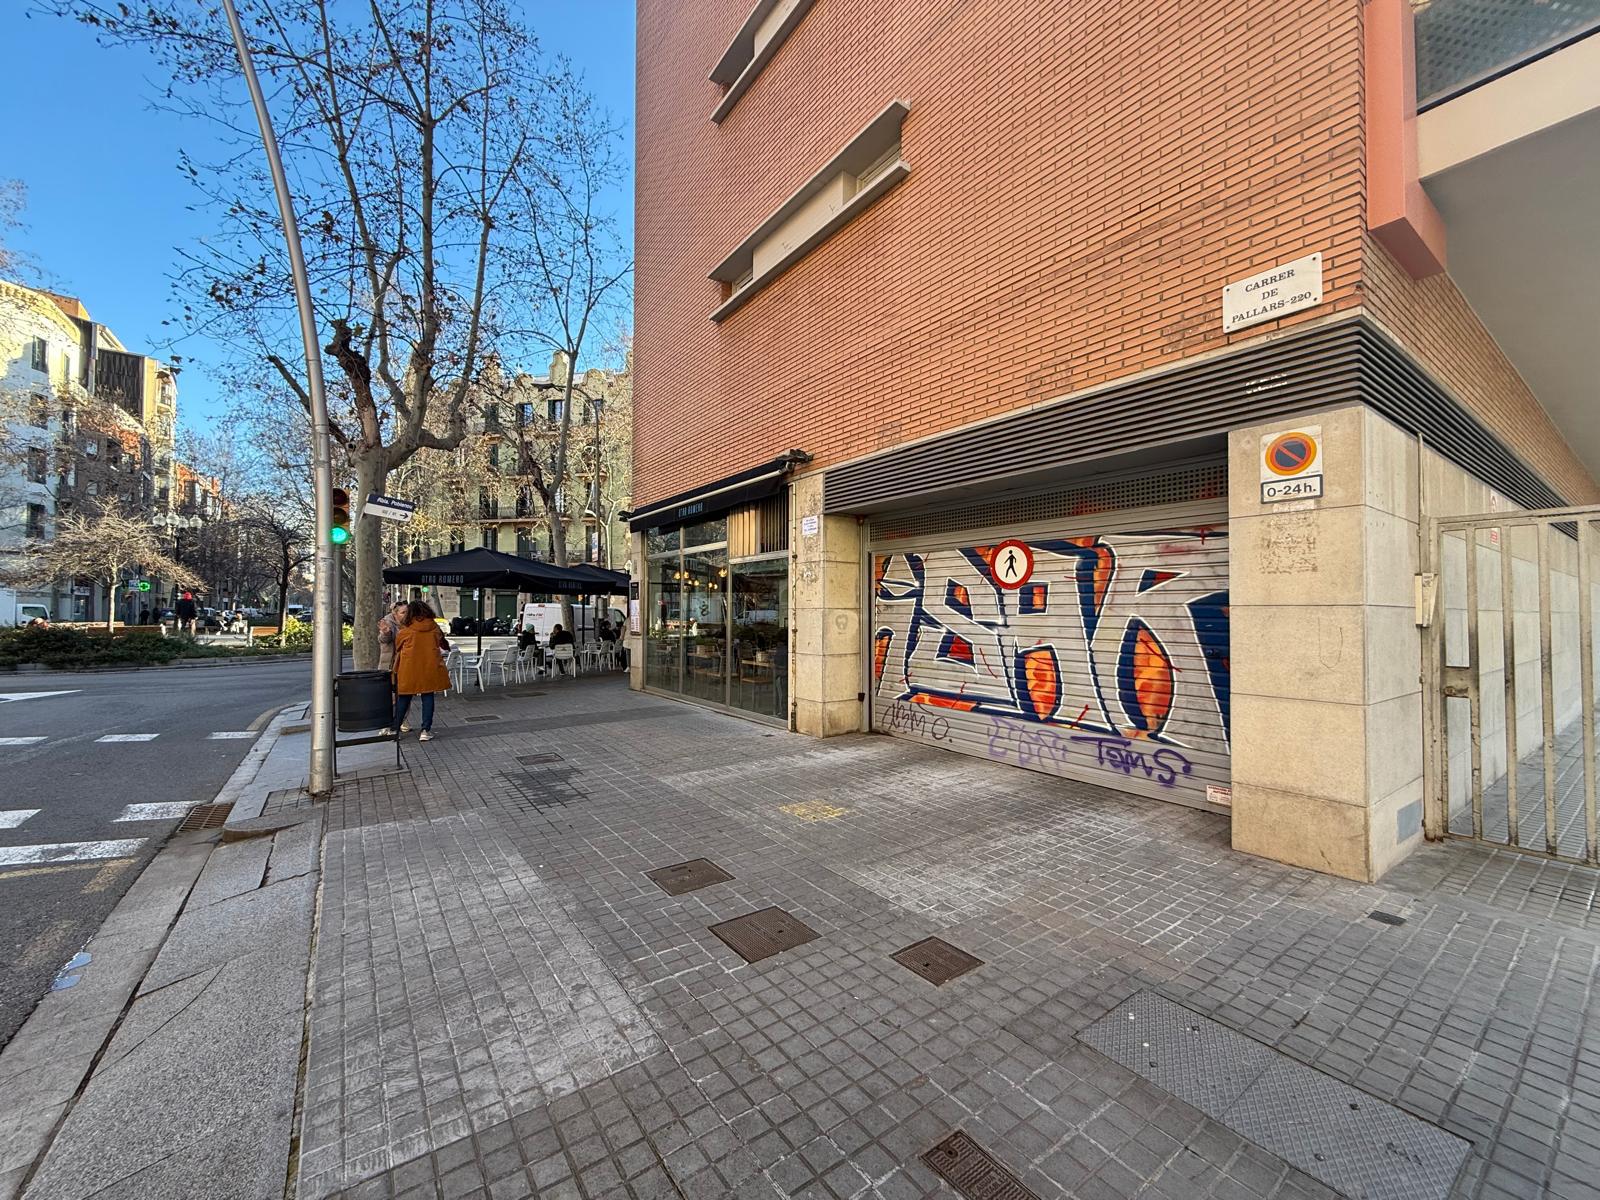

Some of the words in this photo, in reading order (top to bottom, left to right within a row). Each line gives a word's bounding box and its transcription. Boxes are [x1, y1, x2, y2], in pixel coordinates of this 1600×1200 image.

[1245, 269, 1295, 293] CARRER
[1261, 288, 1278, 300] DE
[1232, 291, 1311, 323] PALLARS-220
[438, 574, 464, 584] ROMERO
